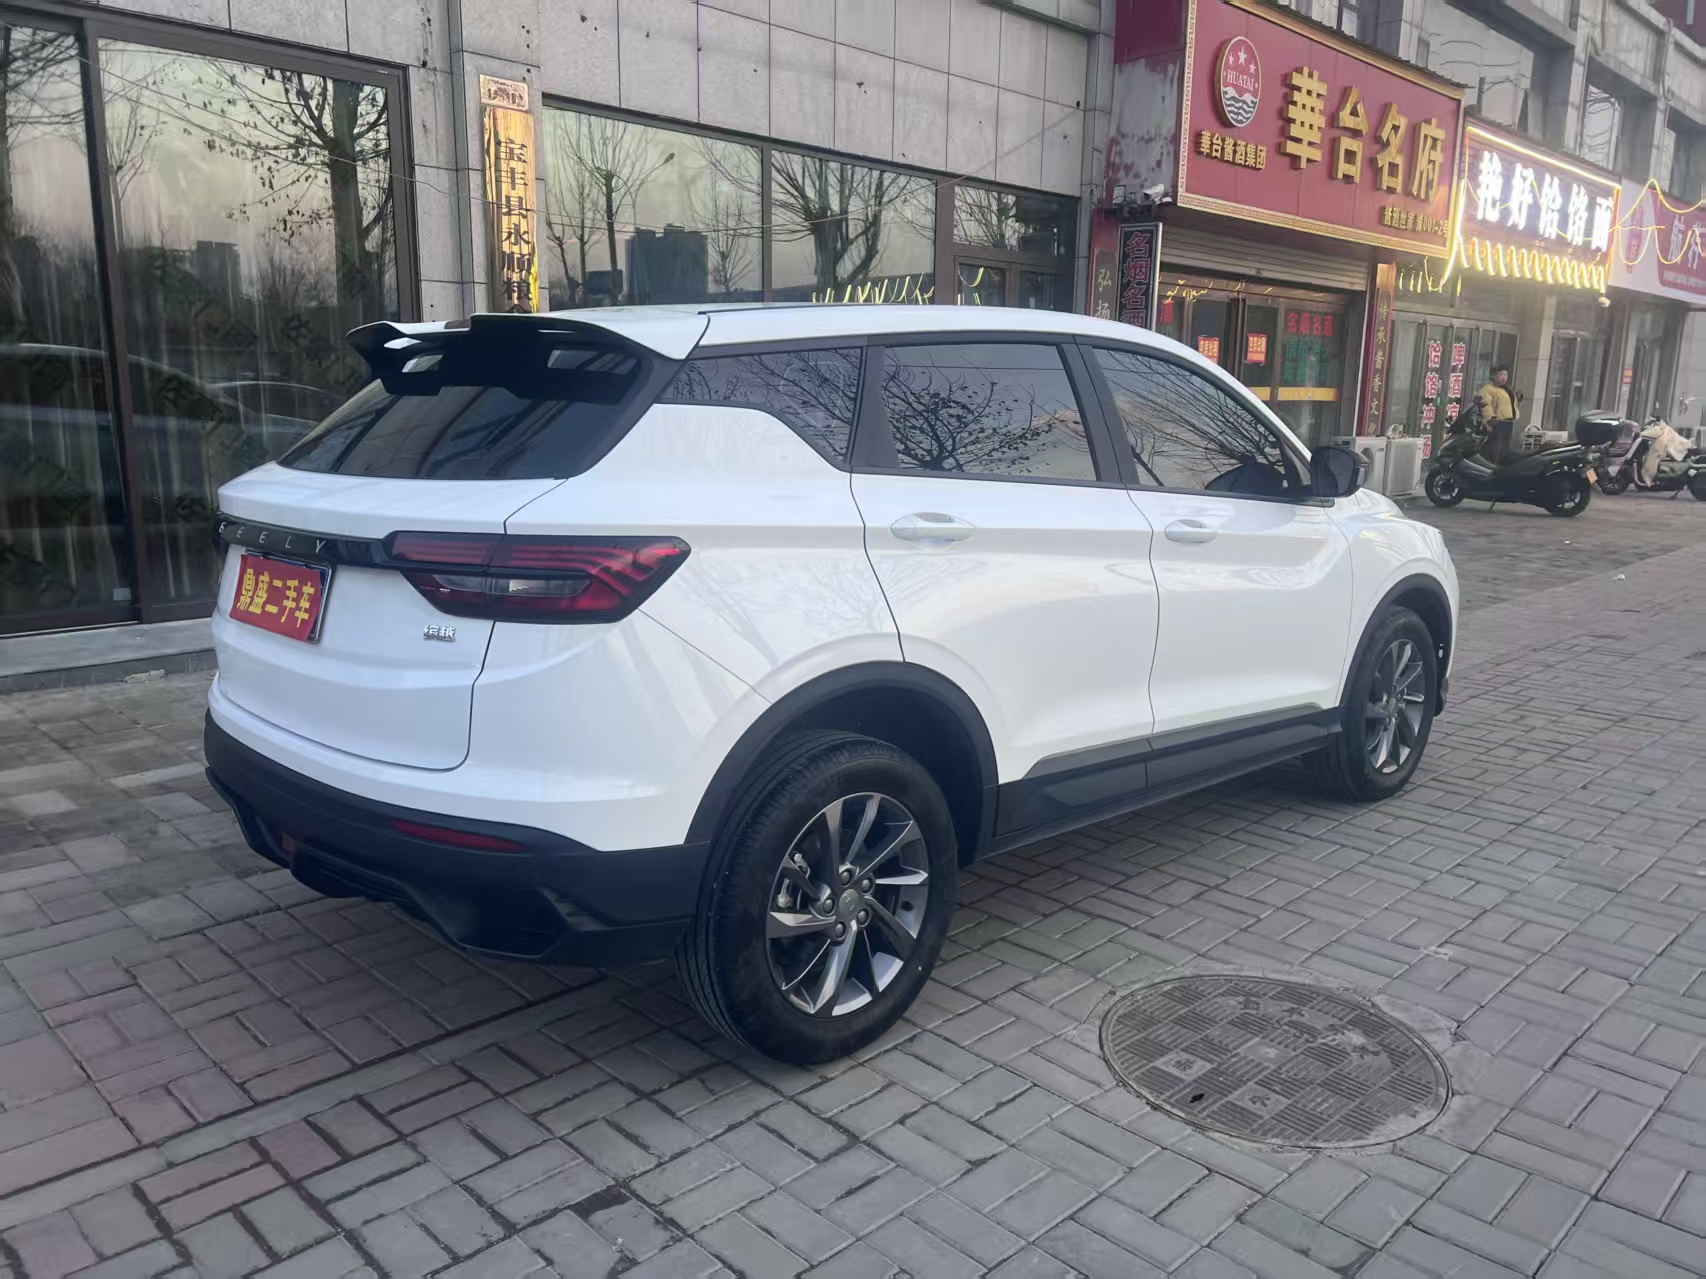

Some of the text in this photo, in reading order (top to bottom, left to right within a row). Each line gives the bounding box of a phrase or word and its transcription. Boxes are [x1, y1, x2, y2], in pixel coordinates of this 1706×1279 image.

[1226, 69, 1255, 91] HUATAI
[1284, 66, 1447, 202] 華台名府
[1095, 267, 1112, 320] 弘扬
[1120, 231, 1151, 328] 名烟名酒
[236, 568, 316, 629] 鼎盛二手车
